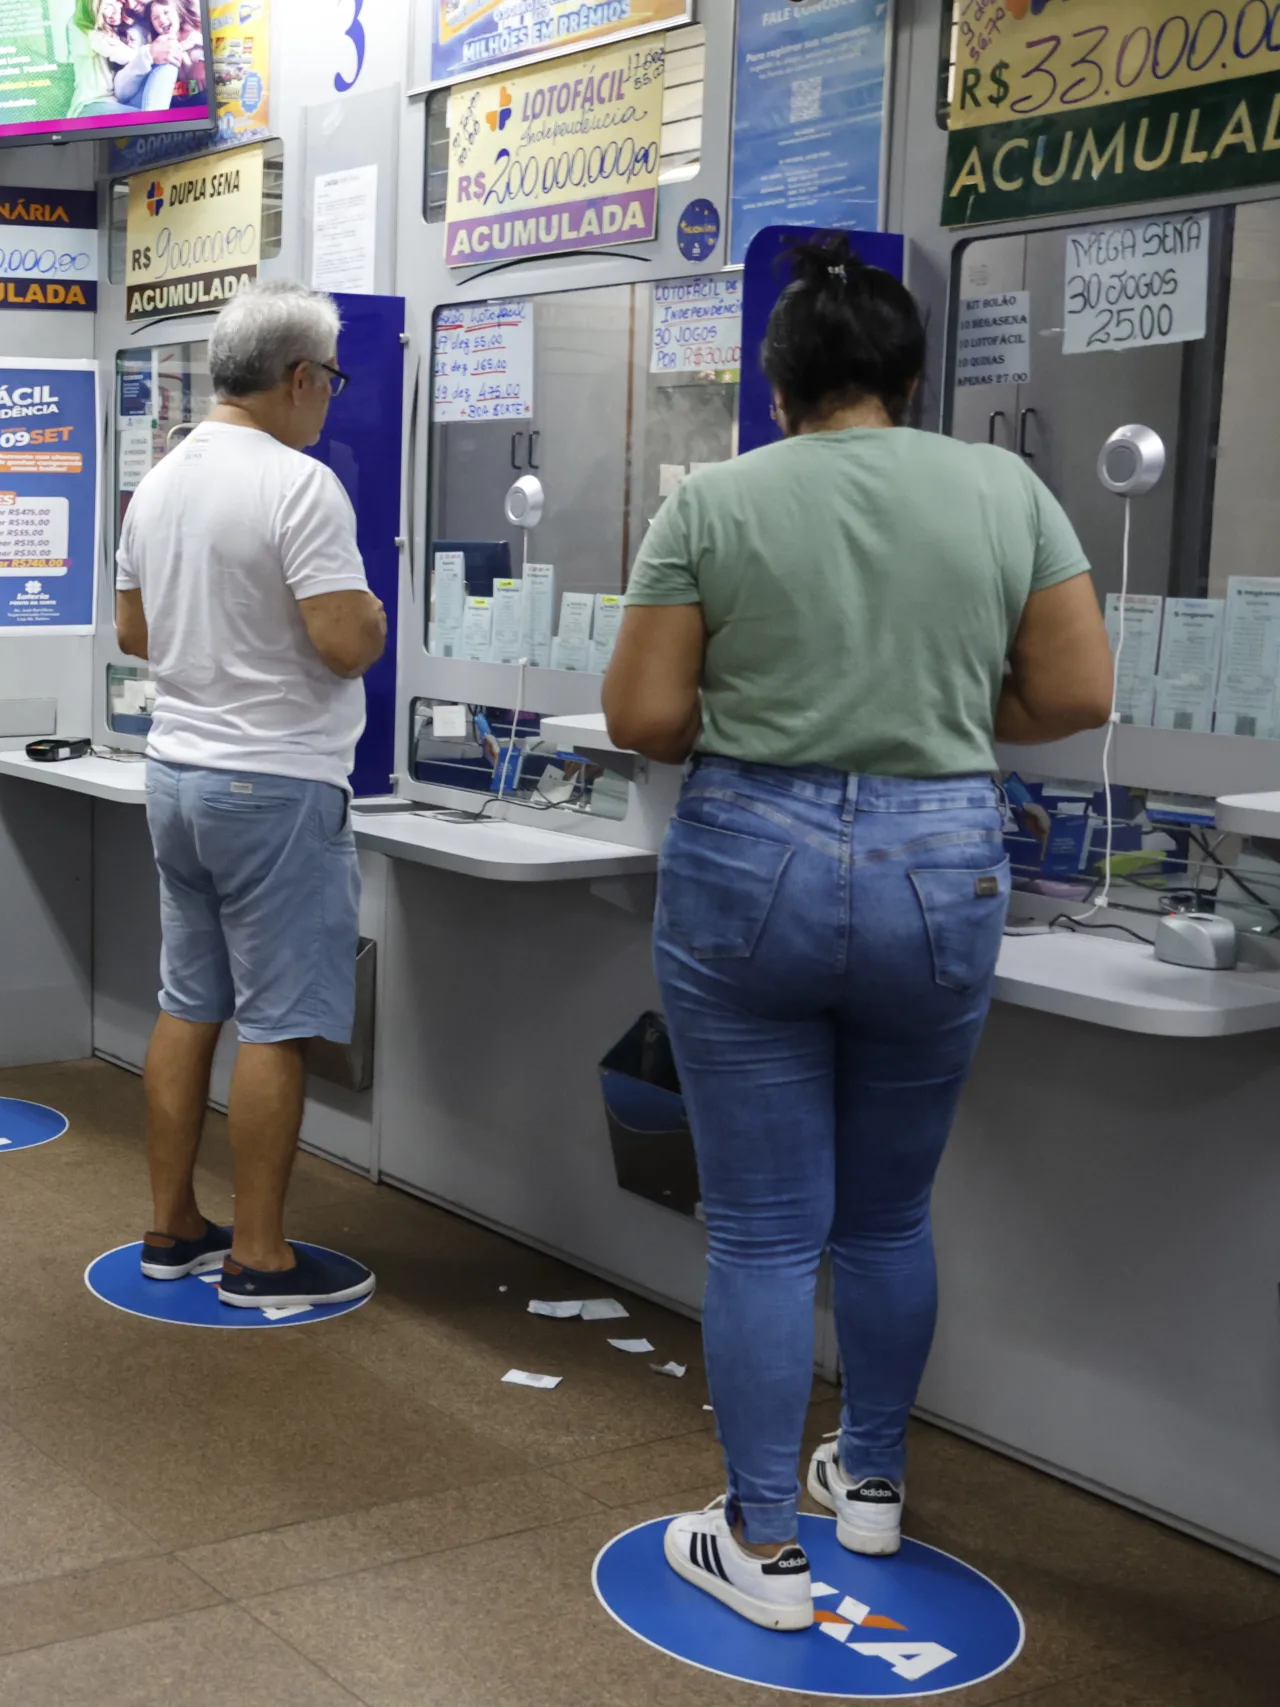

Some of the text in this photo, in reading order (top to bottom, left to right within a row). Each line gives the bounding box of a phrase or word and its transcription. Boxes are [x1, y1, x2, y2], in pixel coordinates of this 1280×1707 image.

[533, 19, 554, 42] EM
[522, 64, 625, 122] LOTOFÁCIL
[959, 60, 1011, 111] R$
[169, 169, 241, 207] DUPLA SENA
[457, 171, 487, 204] R$
[451, 200, 646, 256] ACUMULADA
[1071, 215, 1201, 268] MEGA SENA
[131, 246, 152, 272] R$
[725, 279, 739, 291] DE
[1067, 268, 1178, 314] 30 JOGOS
[654, 325, 718, 347] 30 JOGOS
[656, 350, 677, 367] POR
[860, 1487, 892, 1498] adidas
